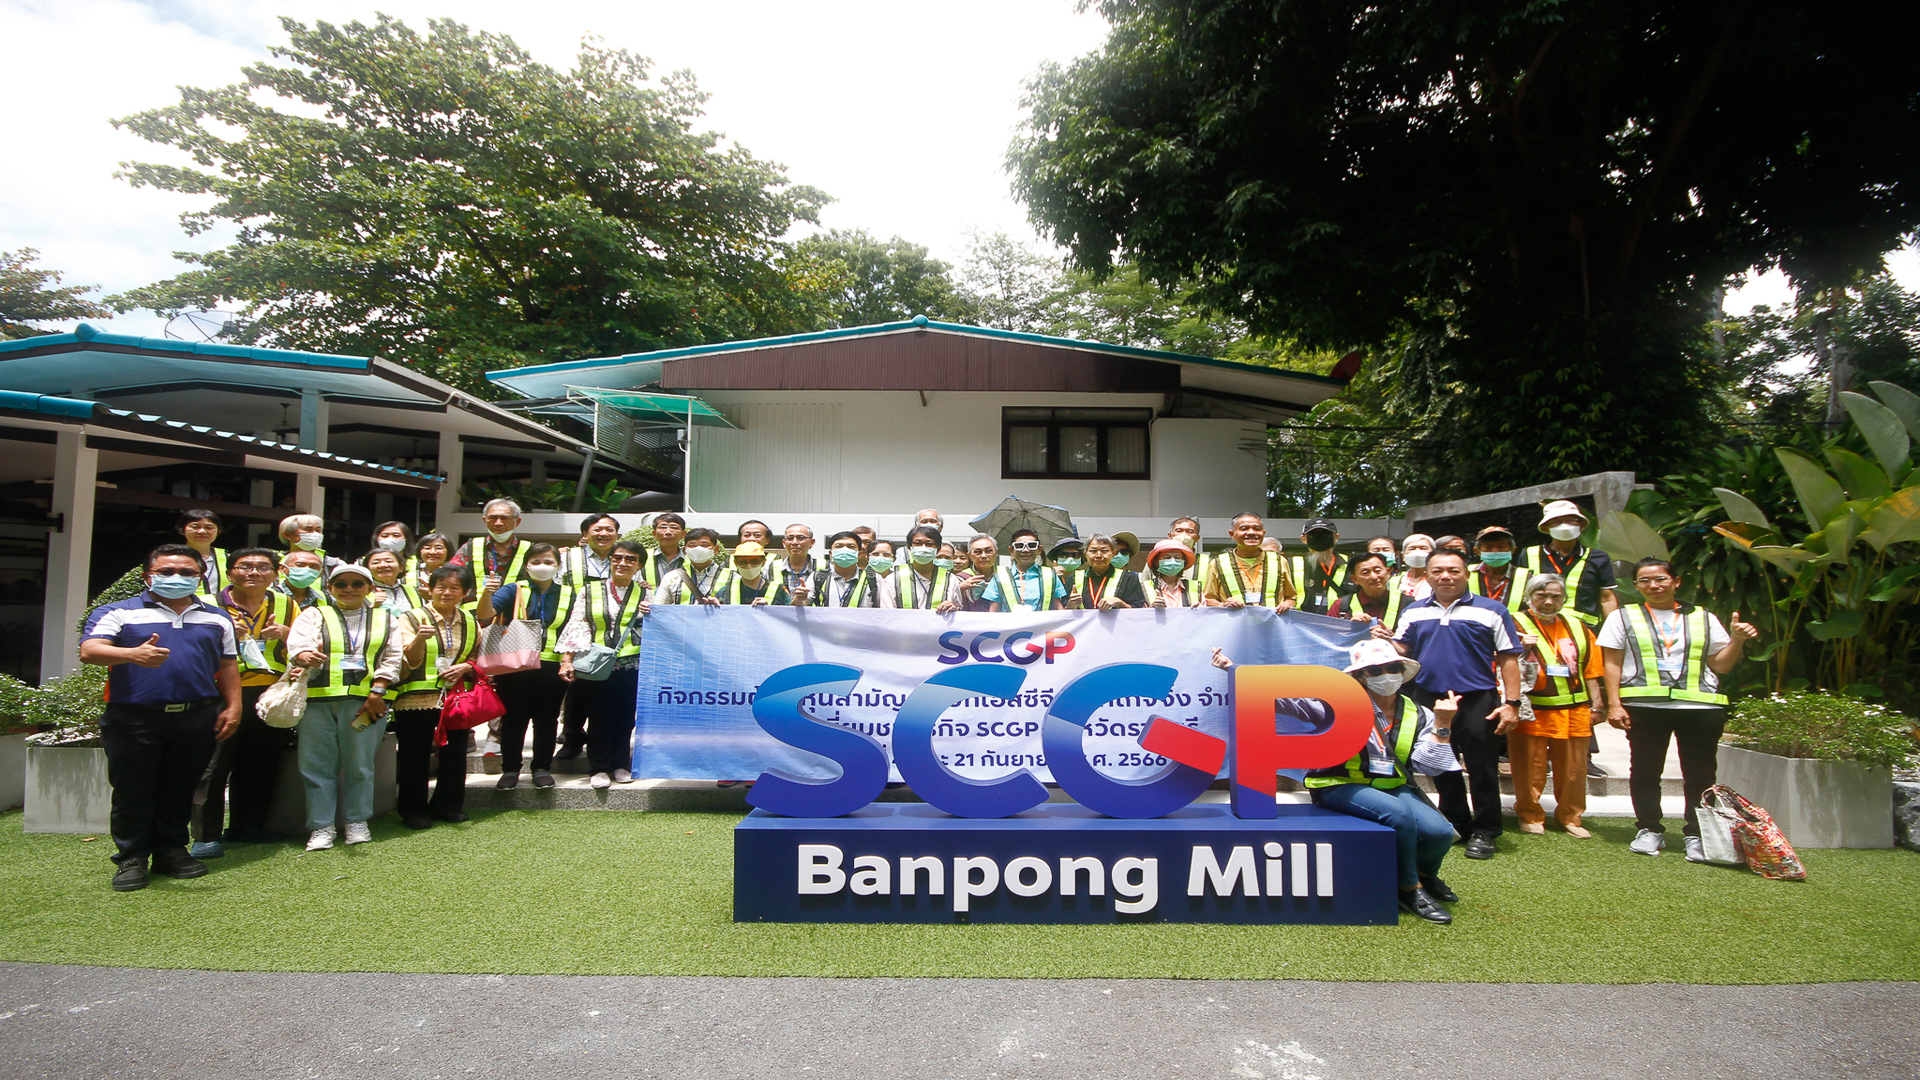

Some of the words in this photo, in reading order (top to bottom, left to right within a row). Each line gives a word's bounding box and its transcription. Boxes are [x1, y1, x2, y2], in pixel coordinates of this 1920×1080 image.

[937, 631, 1076, 665] SCGP
[745, 662, 1375, 819] SCGP
[976, 721, 1039, 737] SCGP
[954, 753, 975, 767] 21
[1117, 753, 1168, 767] 2566
[797, 844, 1159, 914] Banpong
[1187, 842, 1334, 898] Mill
